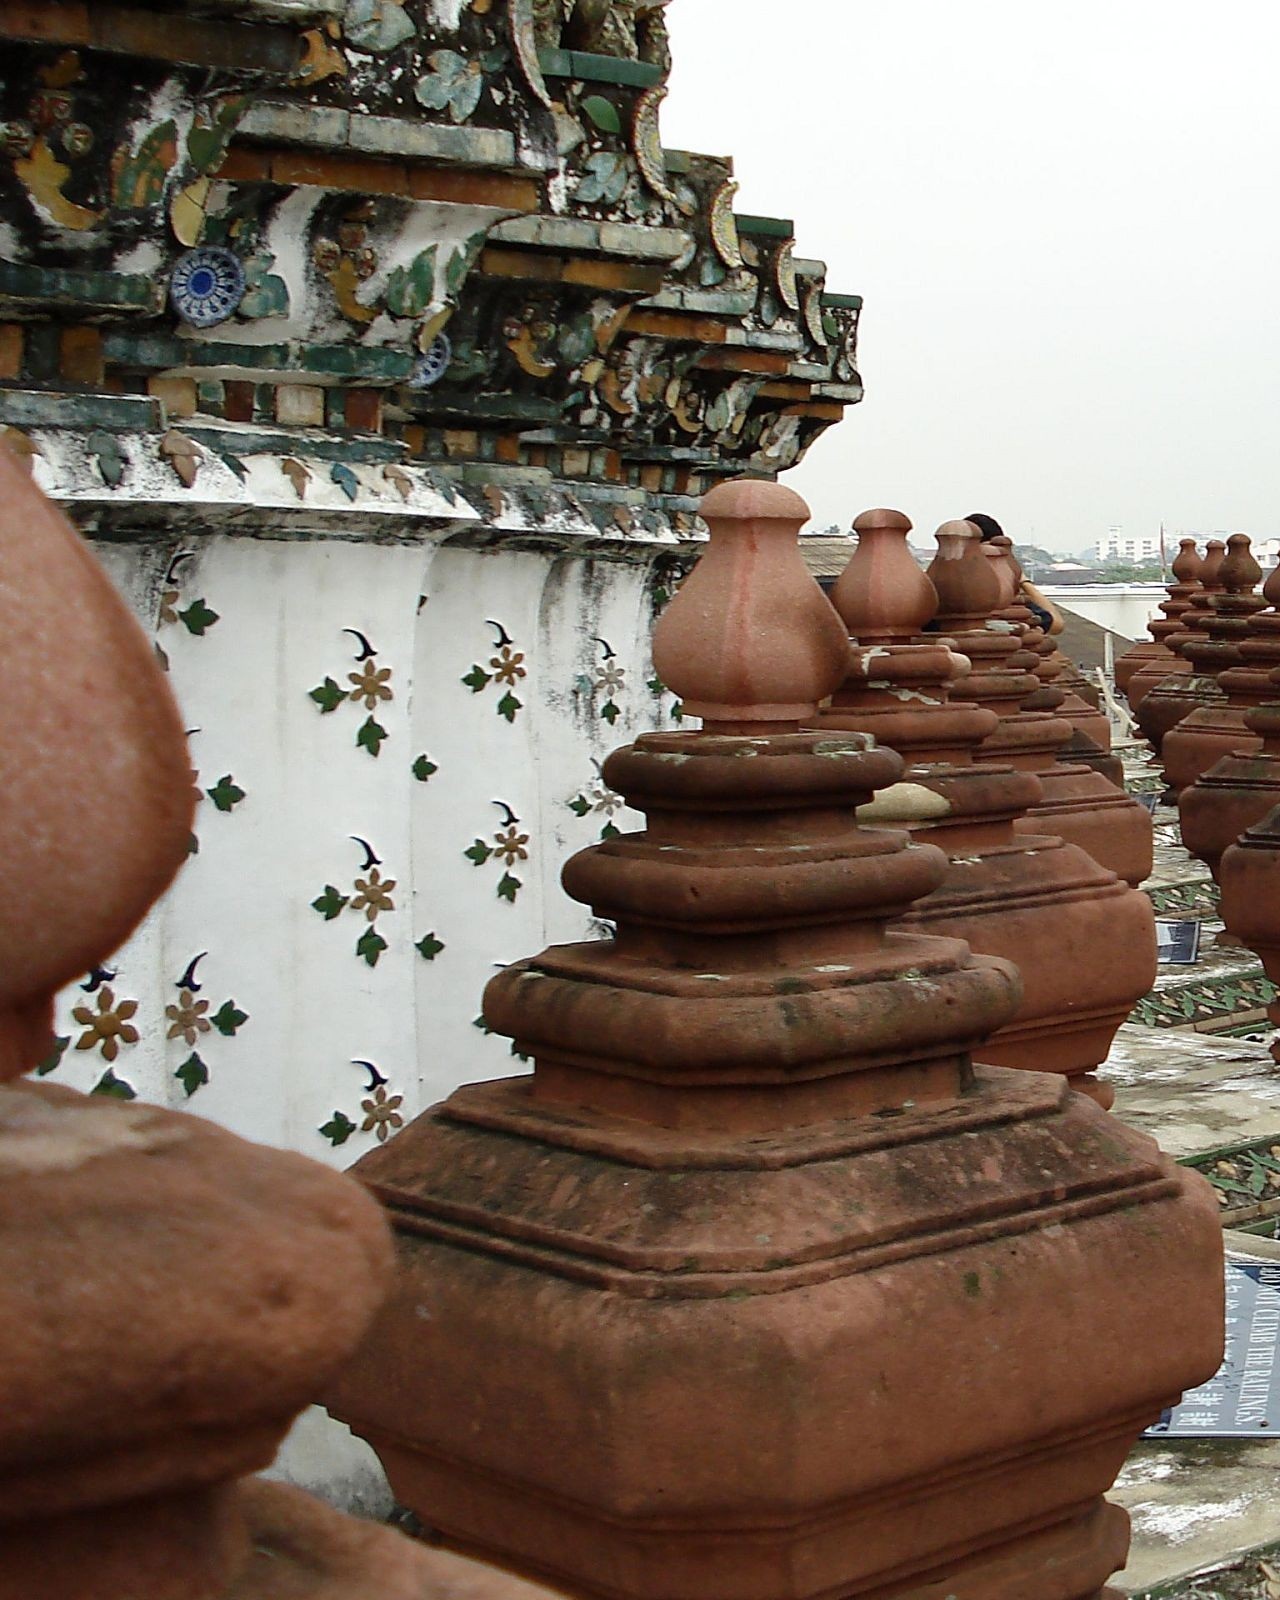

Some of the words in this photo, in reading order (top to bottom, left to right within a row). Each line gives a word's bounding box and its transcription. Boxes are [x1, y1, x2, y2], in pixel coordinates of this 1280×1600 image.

[1249, 1308, 1280, 1343] CLIMB
[1244, 1346, 1276, 1367] THE
[1234, 1369, 1272, 1425] RAILINGS.
